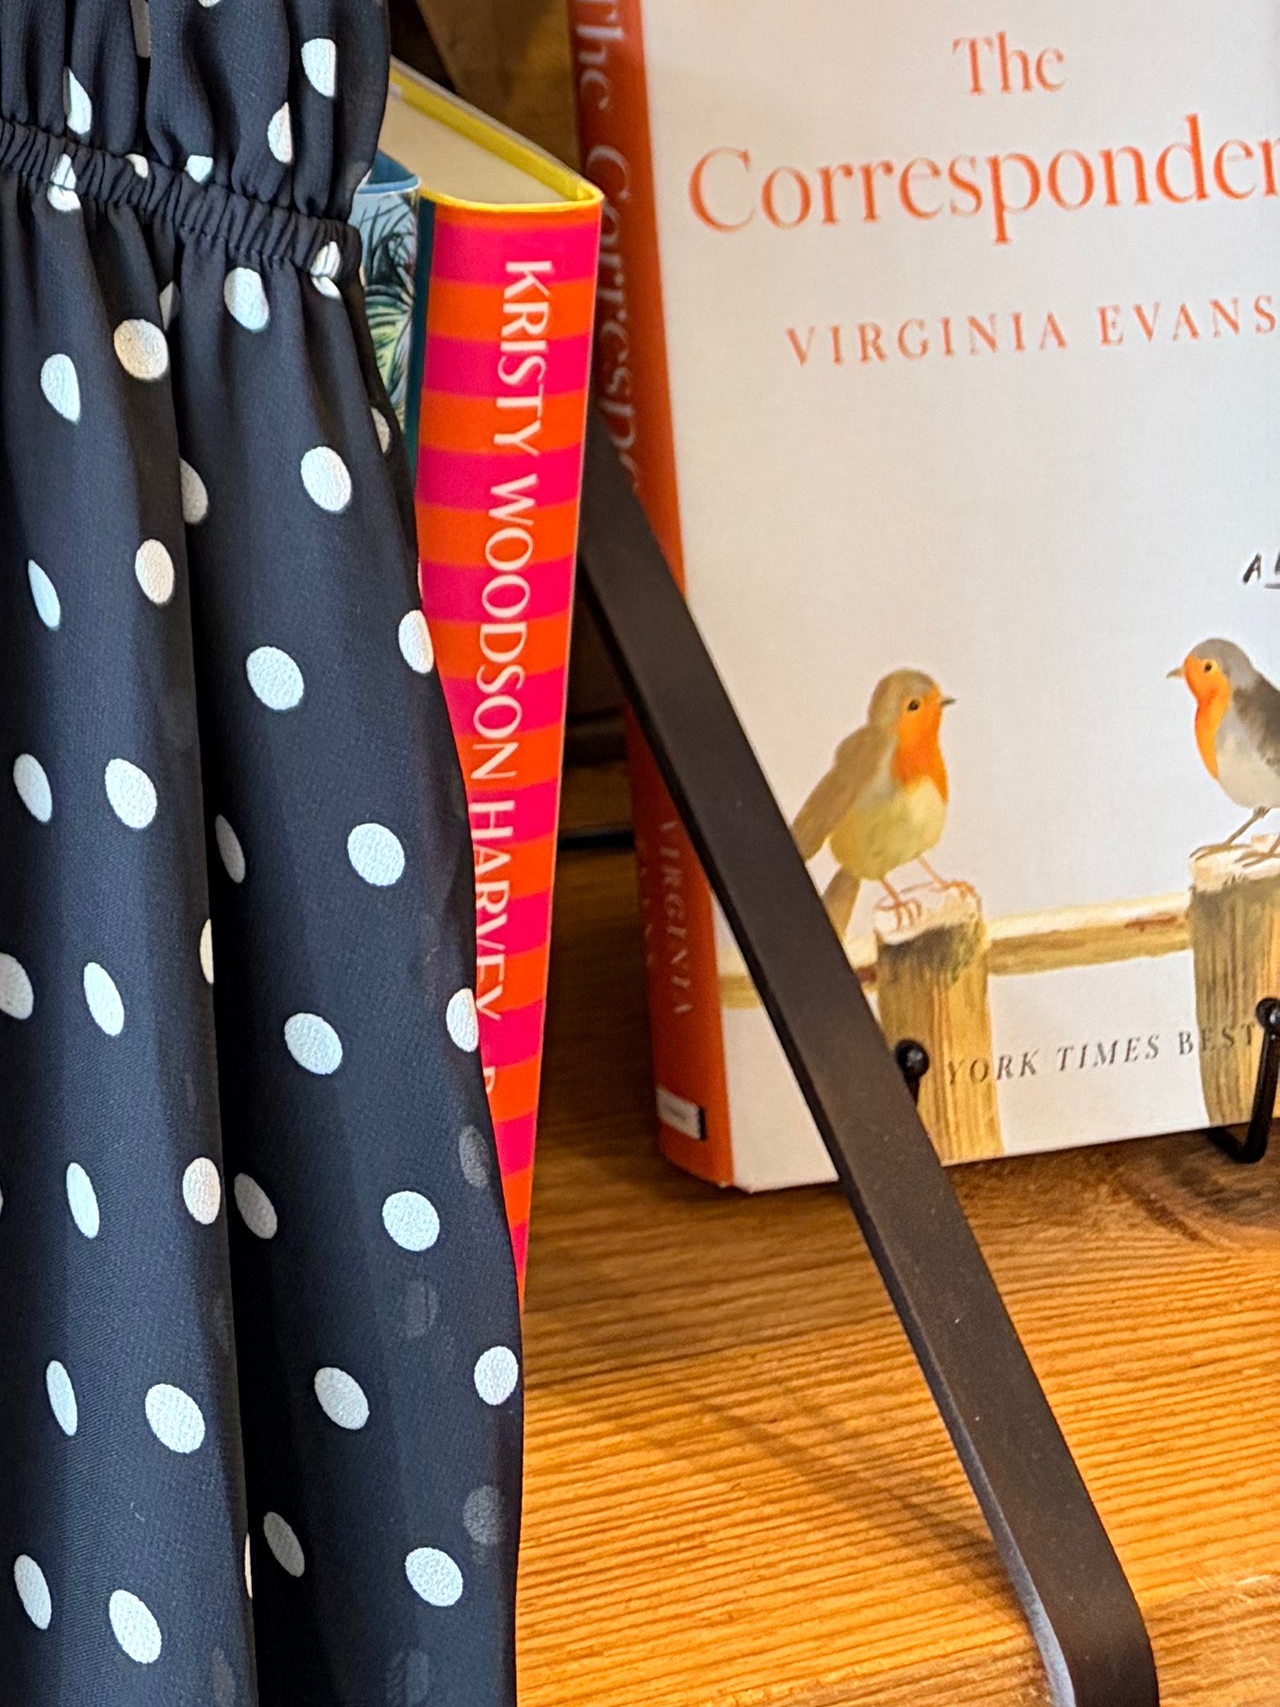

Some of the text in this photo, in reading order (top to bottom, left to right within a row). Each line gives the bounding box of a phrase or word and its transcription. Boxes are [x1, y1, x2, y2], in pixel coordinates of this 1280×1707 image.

[952, 30, 1066, 96] The
[785, 294, 1277, 367] VIRGINIA EVANS
[468, 257, 554, 1021] KRISTY WOODSON HARVEY
[944, 1048, 1040, 1087] YORK
[1056, 1034, 1160, 1072] TIMES
